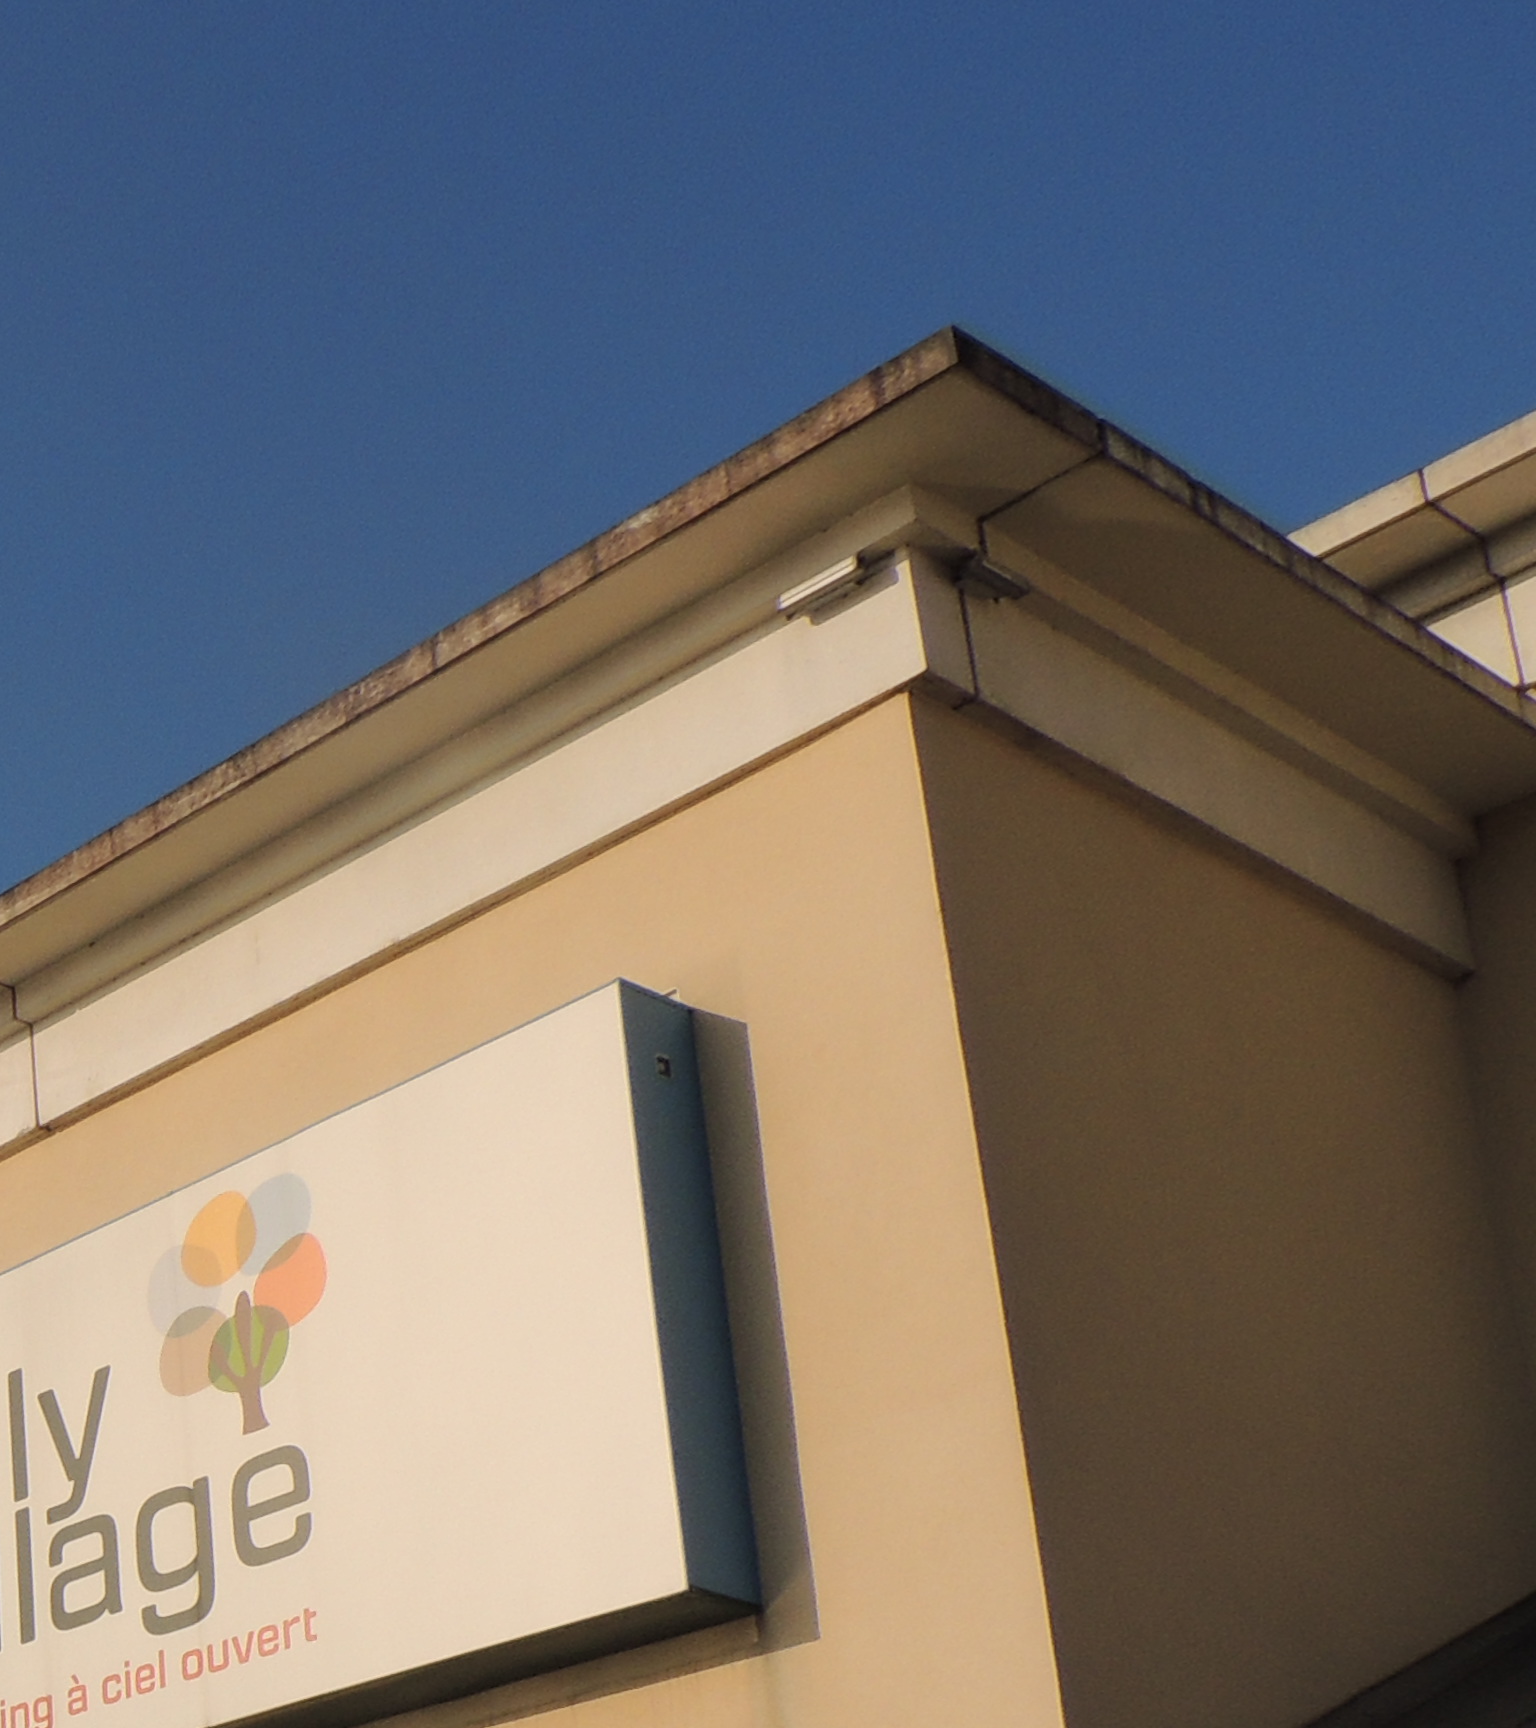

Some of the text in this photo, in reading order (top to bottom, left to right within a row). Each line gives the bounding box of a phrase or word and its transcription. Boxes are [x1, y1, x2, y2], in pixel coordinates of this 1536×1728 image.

[66, 1674, 89, 1716] à
[101, 1649, 168, 1705] ciel
[180, 1607, 319, 1681] ouvert
